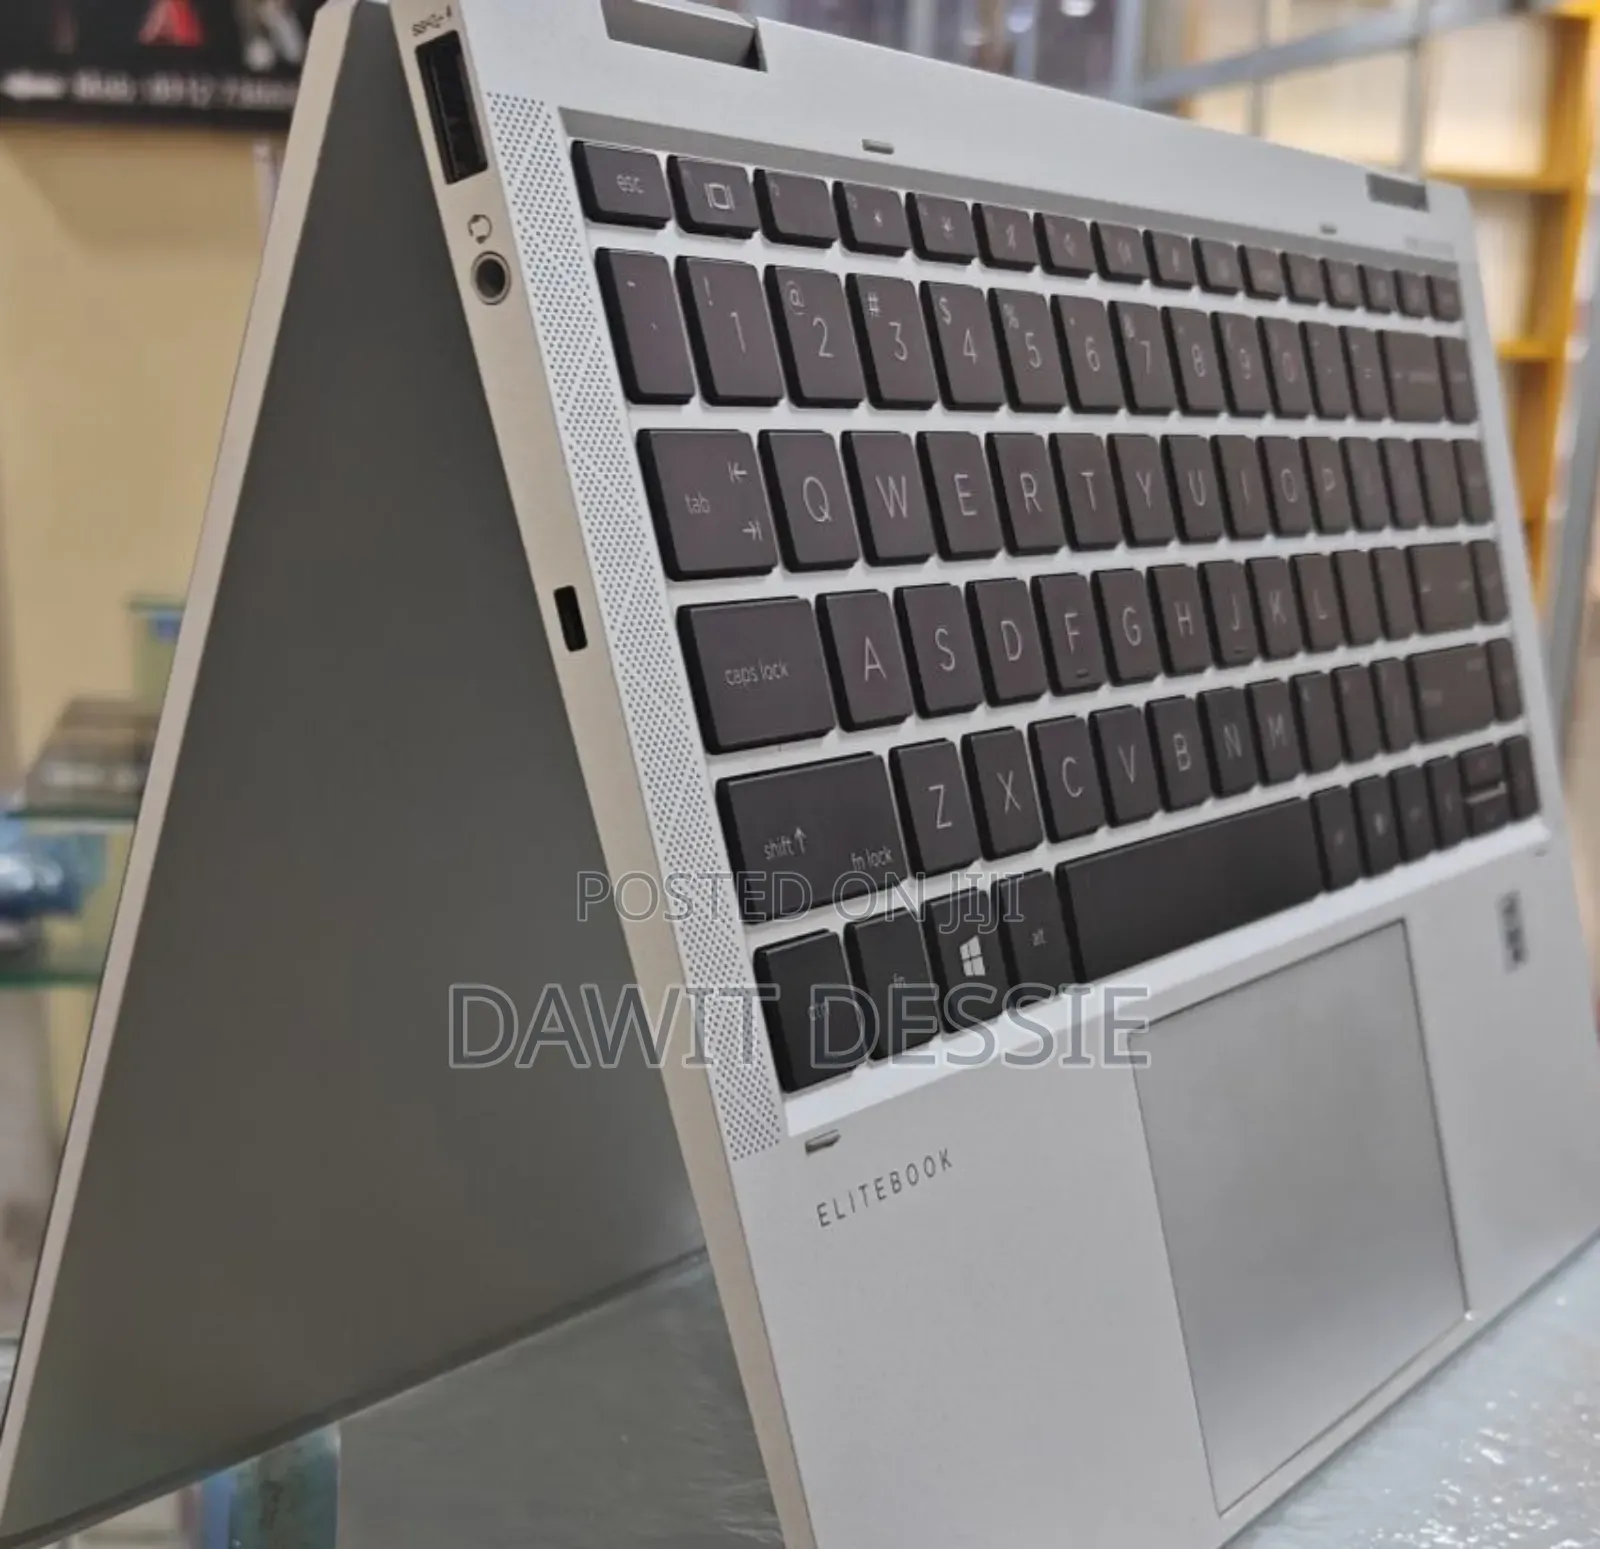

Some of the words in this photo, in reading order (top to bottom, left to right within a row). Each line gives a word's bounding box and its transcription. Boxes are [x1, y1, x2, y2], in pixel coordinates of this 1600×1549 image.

[616, 173, 645, 194] esc
[703, 276, 713, 306] !
[783, 280, 804, 315] @
[867, 291, 881, 316] #
[937, 297, 952, 325] $
[730, 311, 747, 354] 1
[812, 317, 834, 358] 2
[888, 321, 908, 361] 3
[962, 327, 978, 363] 4
[1025, 331, 1042, 368] 5
[1085, 335, 1100, 372] 6
[1140, 340, 1150, 375] 7
[1191, 343, 1206, 378] 8
[801, 476, 833, 523] Q
[874, 474, 908, 519] W
[953, 473, 978, 516] E
[1019, 472, 1042, 514] R
[1080, 471, 1097, 510] T
[1135, 471, 1152, 508] Y
[1188, 469, 1207, 507] U
[1279, 467, 1298, 503] O
[685, 492, 711, 516] tab
[1174, 601, 1194, 637] H
[1231, 592, 1241, 632] J
[1269, 590, 1287, 625] K
[1312, 588, 1328, 620] L
[1001, 619, 1022, 662] D
[1064, 611, 1081, 654] F
[1122, 605, 1143, 646] G
[864, 636, 886, 682] A
[934, 628, 956, 671] S
[725, 662, 759, 688] caps
[760, 658, 791, 680] lock
[1222, 722, 1243, 759] N
[1268, 712, 1289, 748] M
[1117, 743, 1135, 785] V
[1173, 732, 1192, 772] B
[996, 770, 1022, 815] X
[1061, 756, 1084, 798] C
[928, 783, 953, 829] Z
[763, 835, 796, 861] shift
[864, 846, 893, 868] lock
[816, 1147, 953, 1228] ELITEBOOK
